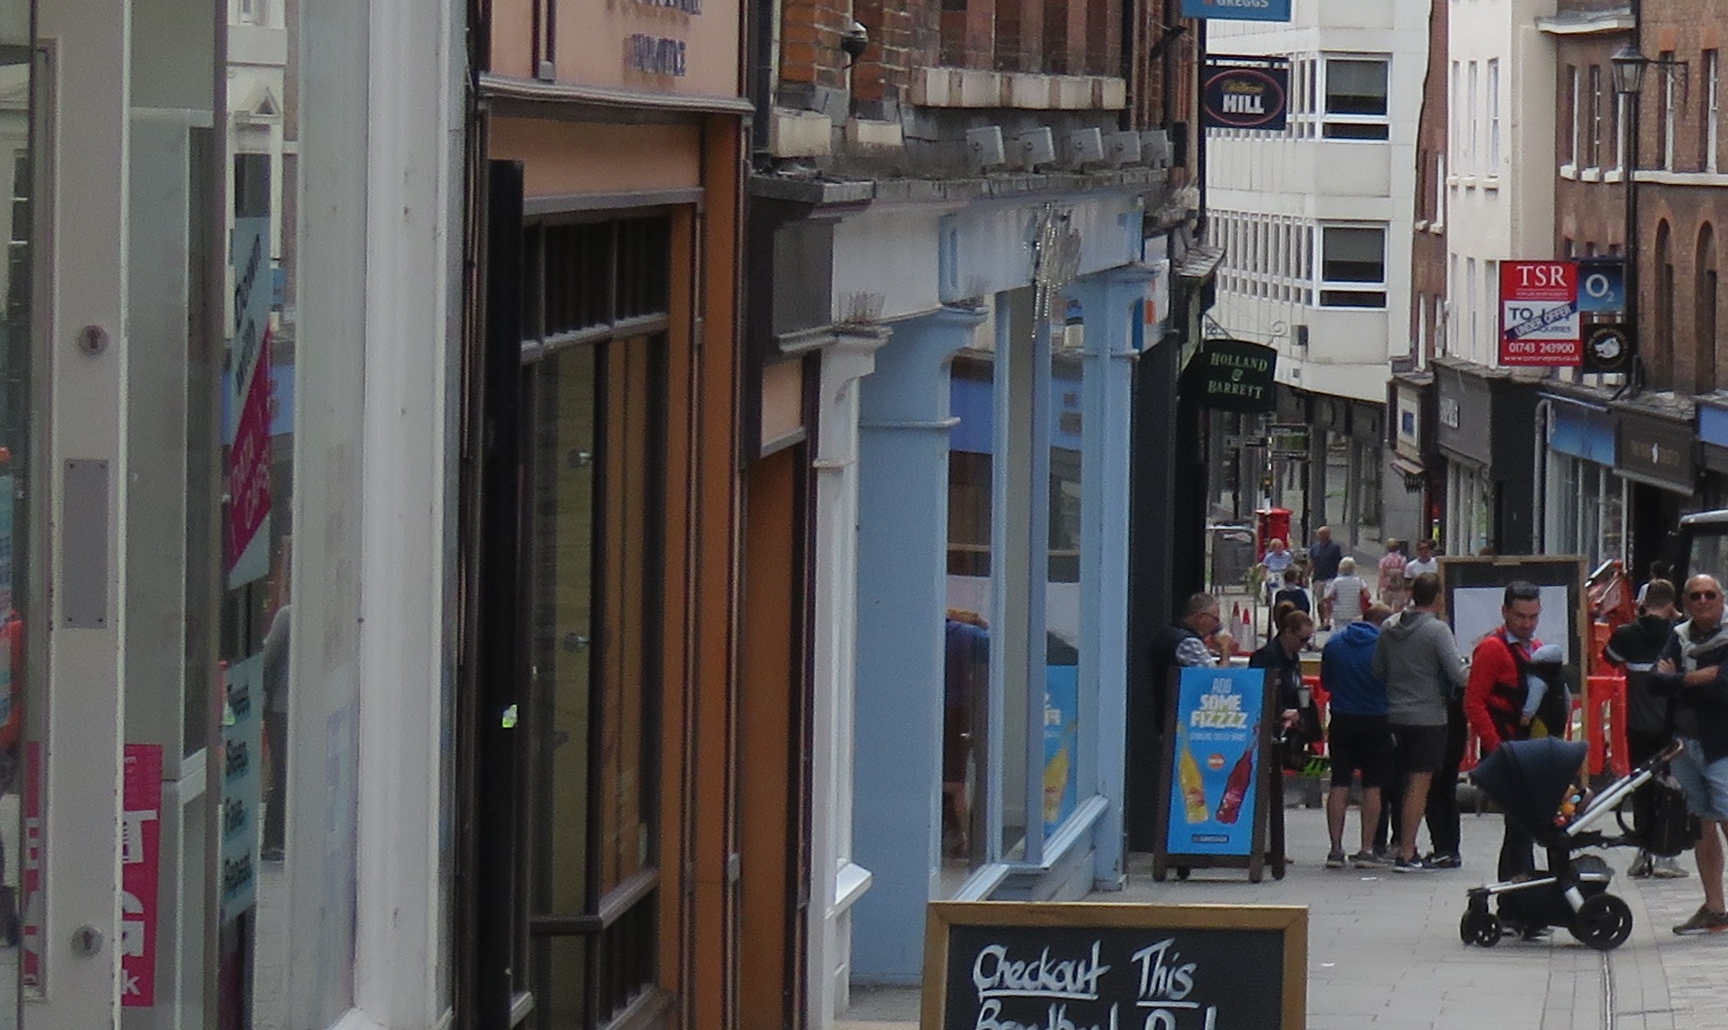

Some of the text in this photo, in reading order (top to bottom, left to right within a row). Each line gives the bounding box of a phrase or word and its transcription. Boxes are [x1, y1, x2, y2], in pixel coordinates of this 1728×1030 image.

[1222, 93, 1265, 114] HILL
[1516, 265, 1568, 287] TSR
[1508, 307, 1534, 321] TO
[1508, 342, 1575, 354] 01743 243900
[1210, 352, 1268, 371] HOLLAND
[1207, 380, 1264, 399] BARRETT
[1199, 694, 1243, 711] SOME
[972, 937, 1199, 1001] Checkout This
